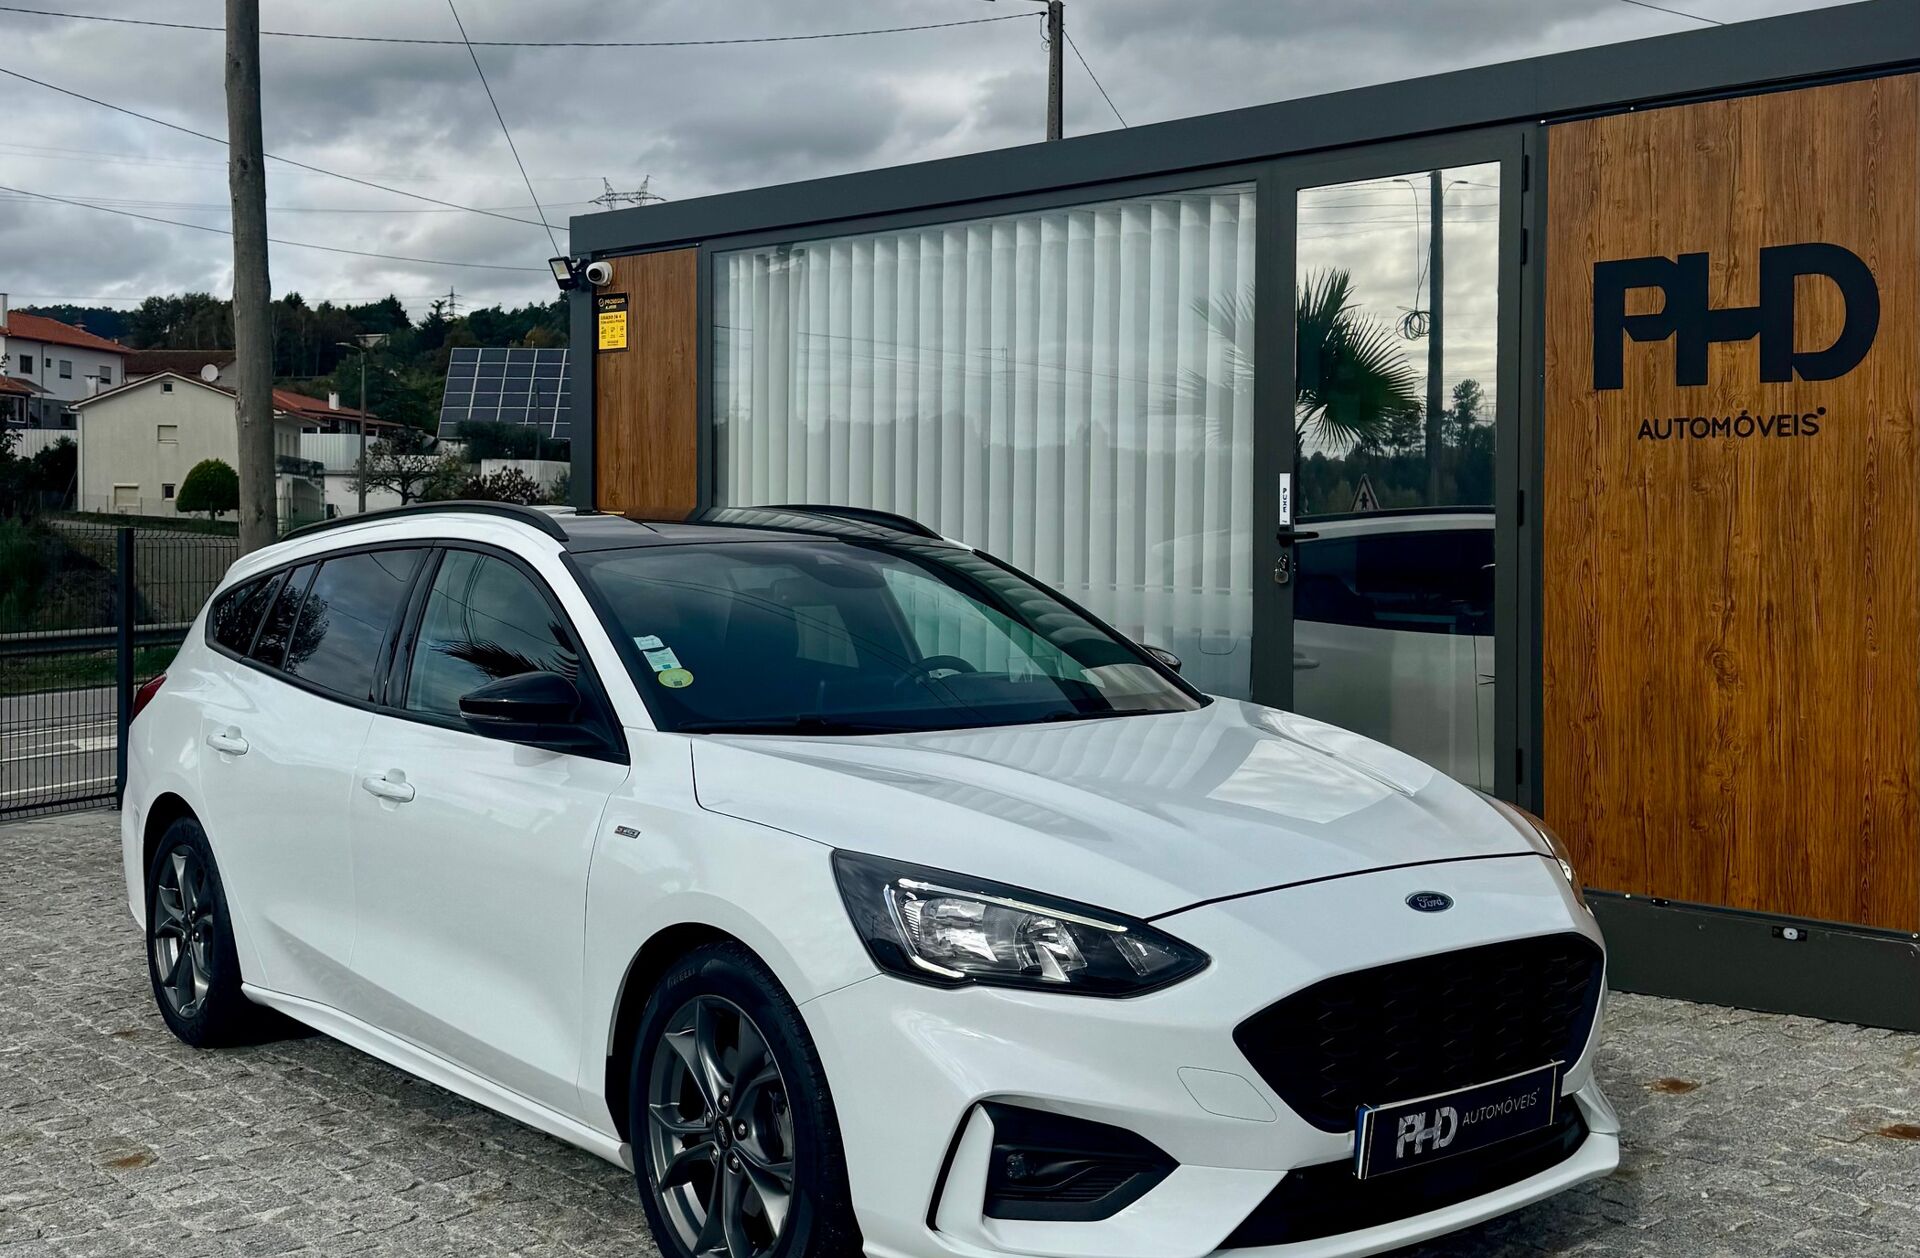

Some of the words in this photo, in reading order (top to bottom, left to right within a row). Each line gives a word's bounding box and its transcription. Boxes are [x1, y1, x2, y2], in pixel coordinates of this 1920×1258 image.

[1593, 242, 1880, 390] PHD
[1637, 410, 1821, 440] AUTOMÓVEIS
[1416, 895, 1445, 909] Ford
[1396, 1106, 1459, 1160] PHD
[1462, 1092, 1538, 1126] AUTOMÓVEIS
